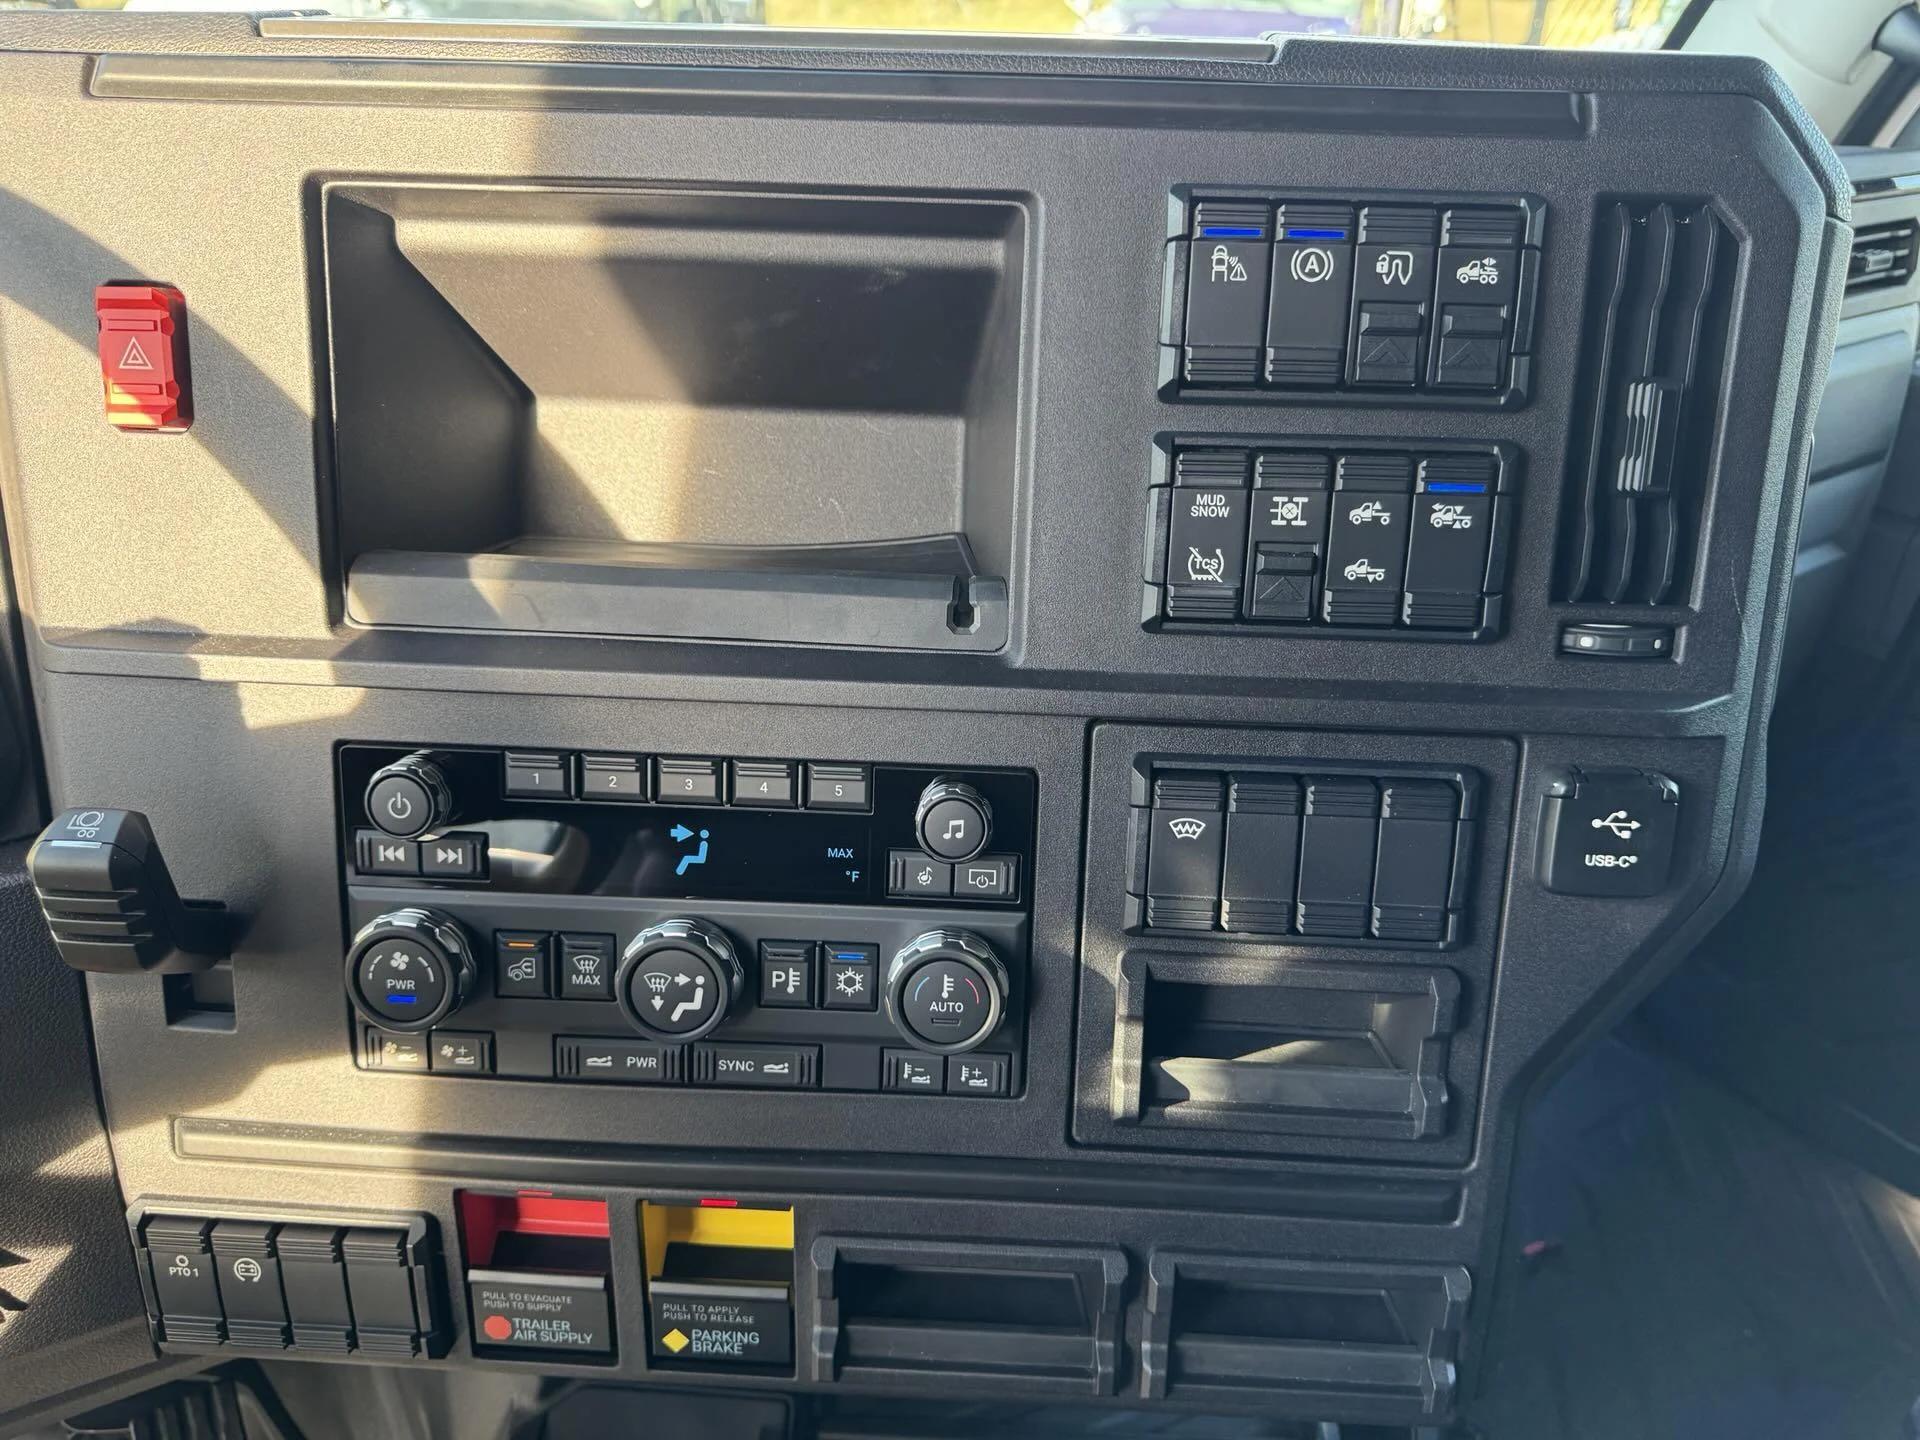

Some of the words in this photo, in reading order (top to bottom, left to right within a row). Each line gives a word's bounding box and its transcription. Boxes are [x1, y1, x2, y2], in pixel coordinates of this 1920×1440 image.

[1304, 255, 1319, 273] A
[1196, 494, 1225, 506] MUD
[1190, 505, 1230, 518] SNOW
[1194, 558, 1219, 570] TCS
[532, 773, 540, 785] 1
[608, 775, 617, 788] 2
[684, 778, 693, 791] 3
[759, 781, 768, 793] 4
[834, 784, 843, 797] 5
[827, 847, 853, 858] MAX
[845, 870, 860, 883] °F
[386, 979, 416, 991] PWR
[572, 974, 600, 986] MAX
[772, 970, 785, 988] P
[929, 1001, 964, 1013] AUTO
[626, 1056, 658, 1069] PWR
[718, 1059, 755, 1073] SYNC
[169, 1266, 191, 1277] PTO
[482, 1291, 507, 1301] PULL
[509, 1292, 521, 1301] TO
[523, 1294, 573, 1304] EVACUATE
[483, 1299, 510, 1309] PUSH
[512, 1301, 524, 1310] TO
[526, 1303, 562, 1312] SUPPLY
[663, 1303, 688, 1312] PULL
[692, 1304, 705, 1313] TO
[708, 1305, 740, 1315] APPLY
[512, 1317, 571, 1331] TRAILER
[663, 1311, 691, 1321] PUSH
[695, 1313, 707, 1322] TO
[710, 1314, 755, 1324] RELEASE
[513, 1330, 537, 1341] AIR
[541, 1331, 592, 1344] SUPPLY
[692, 1328, 760, 1345] PARKING
[692, 1341, 743, 1355] BRAKE
